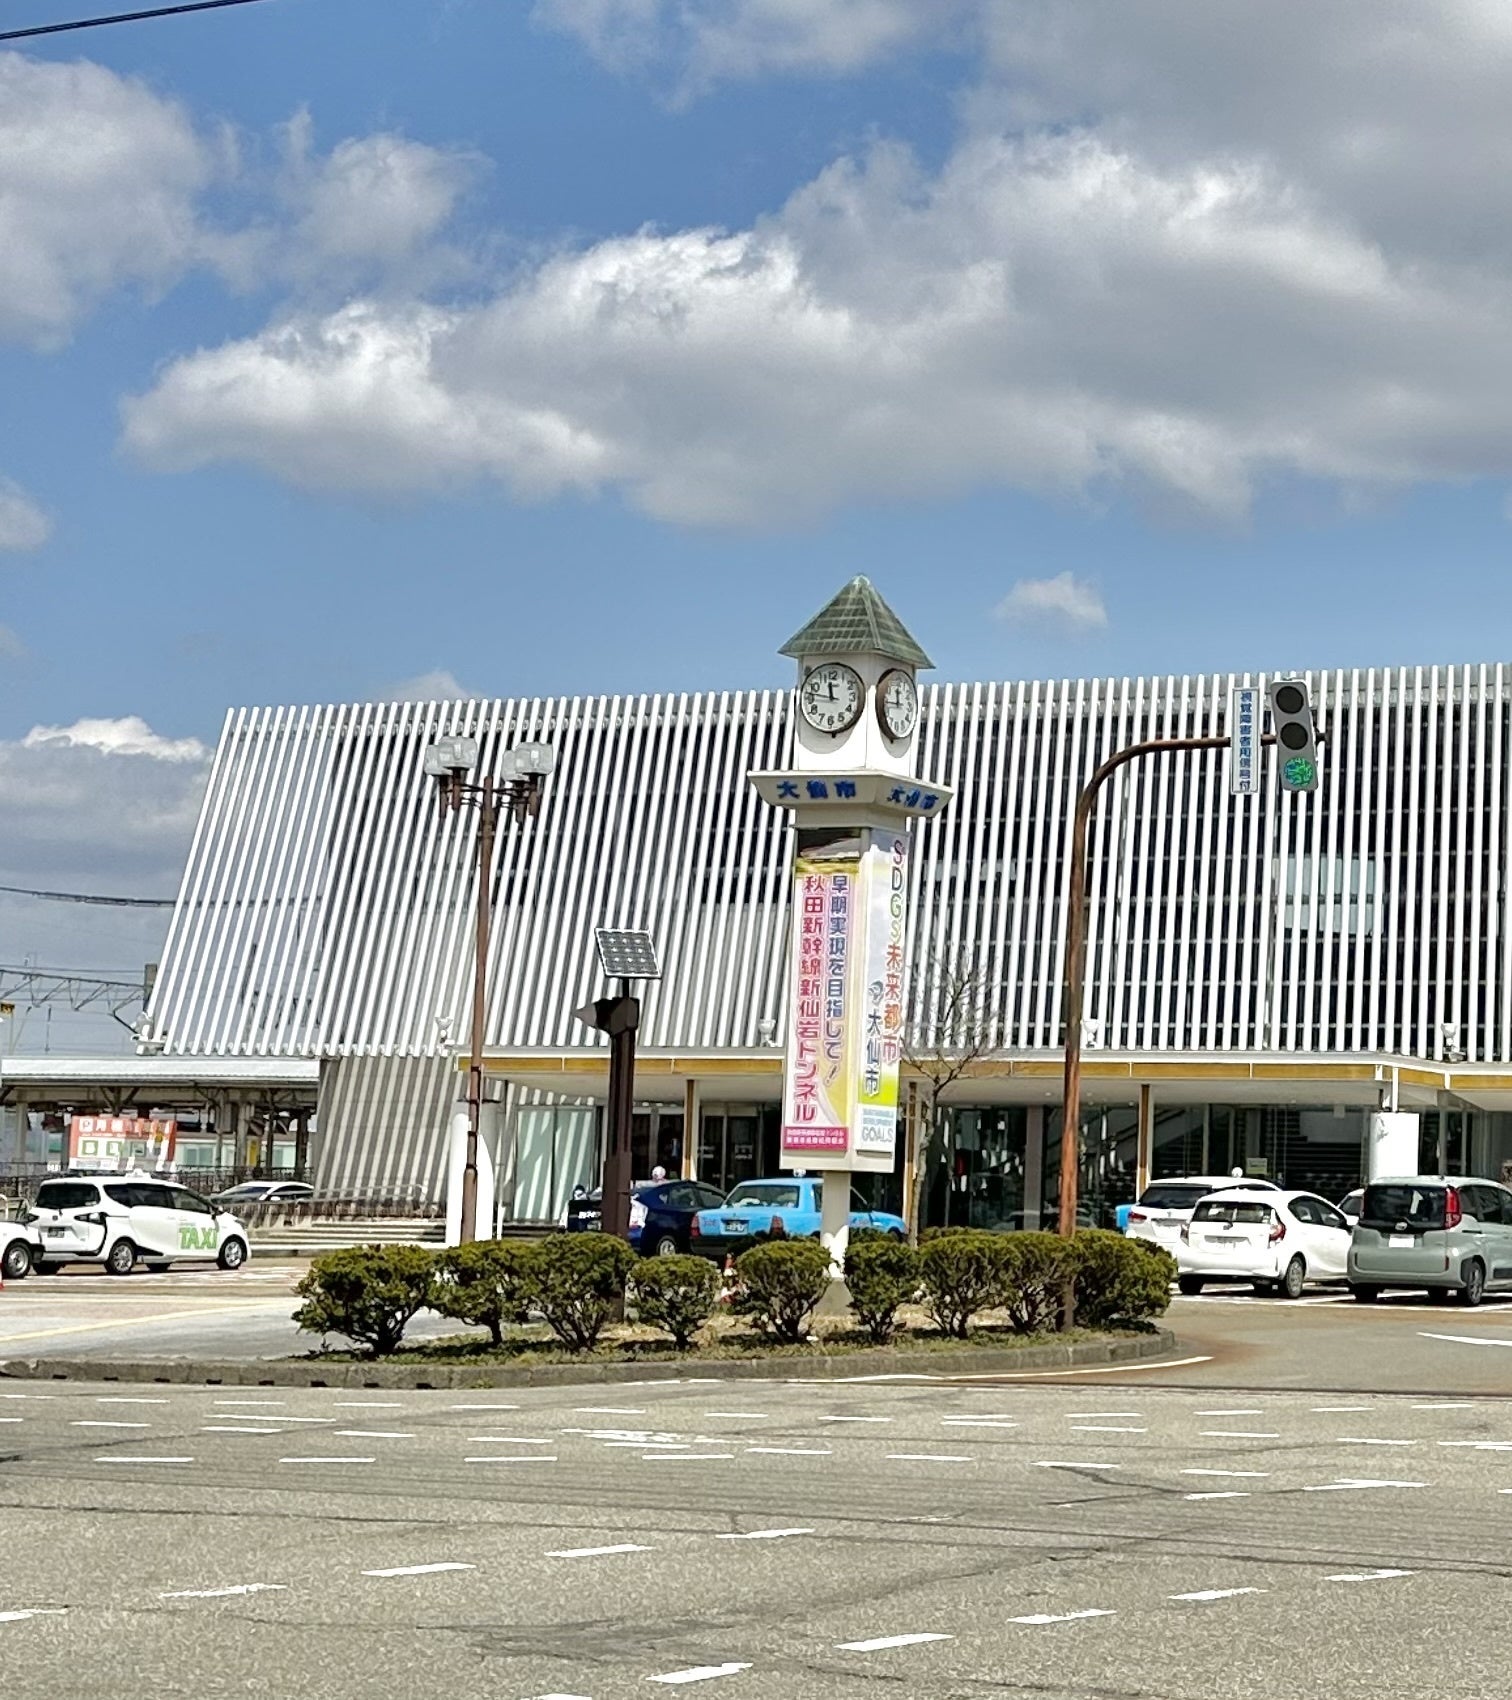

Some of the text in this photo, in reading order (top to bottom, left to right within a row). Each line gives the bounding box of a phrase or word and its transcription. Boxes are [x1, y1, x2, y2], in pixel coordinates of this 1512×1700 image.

[828, 670, 838, 680] 12
[810, 682, 820, 692] 10
[849, 692, 856, 702] 3
[810, 705, 818, 716] 8
[845, 703, 852, 713] 4
[818, 713, 825, 724] 7
[827, 715, 834, 725] 6
[837, 712, 844, 722] 5
[776, 780, 856, 799] 大仙市
[795, 875, 825, 1122] 秋田新幹線新仙岩トンネル
[865, 1010, 881, 1095] 大仙市
[861, 1126, 894, 1142] GOALS
[178, 1227, 217, 1250] TAXI
